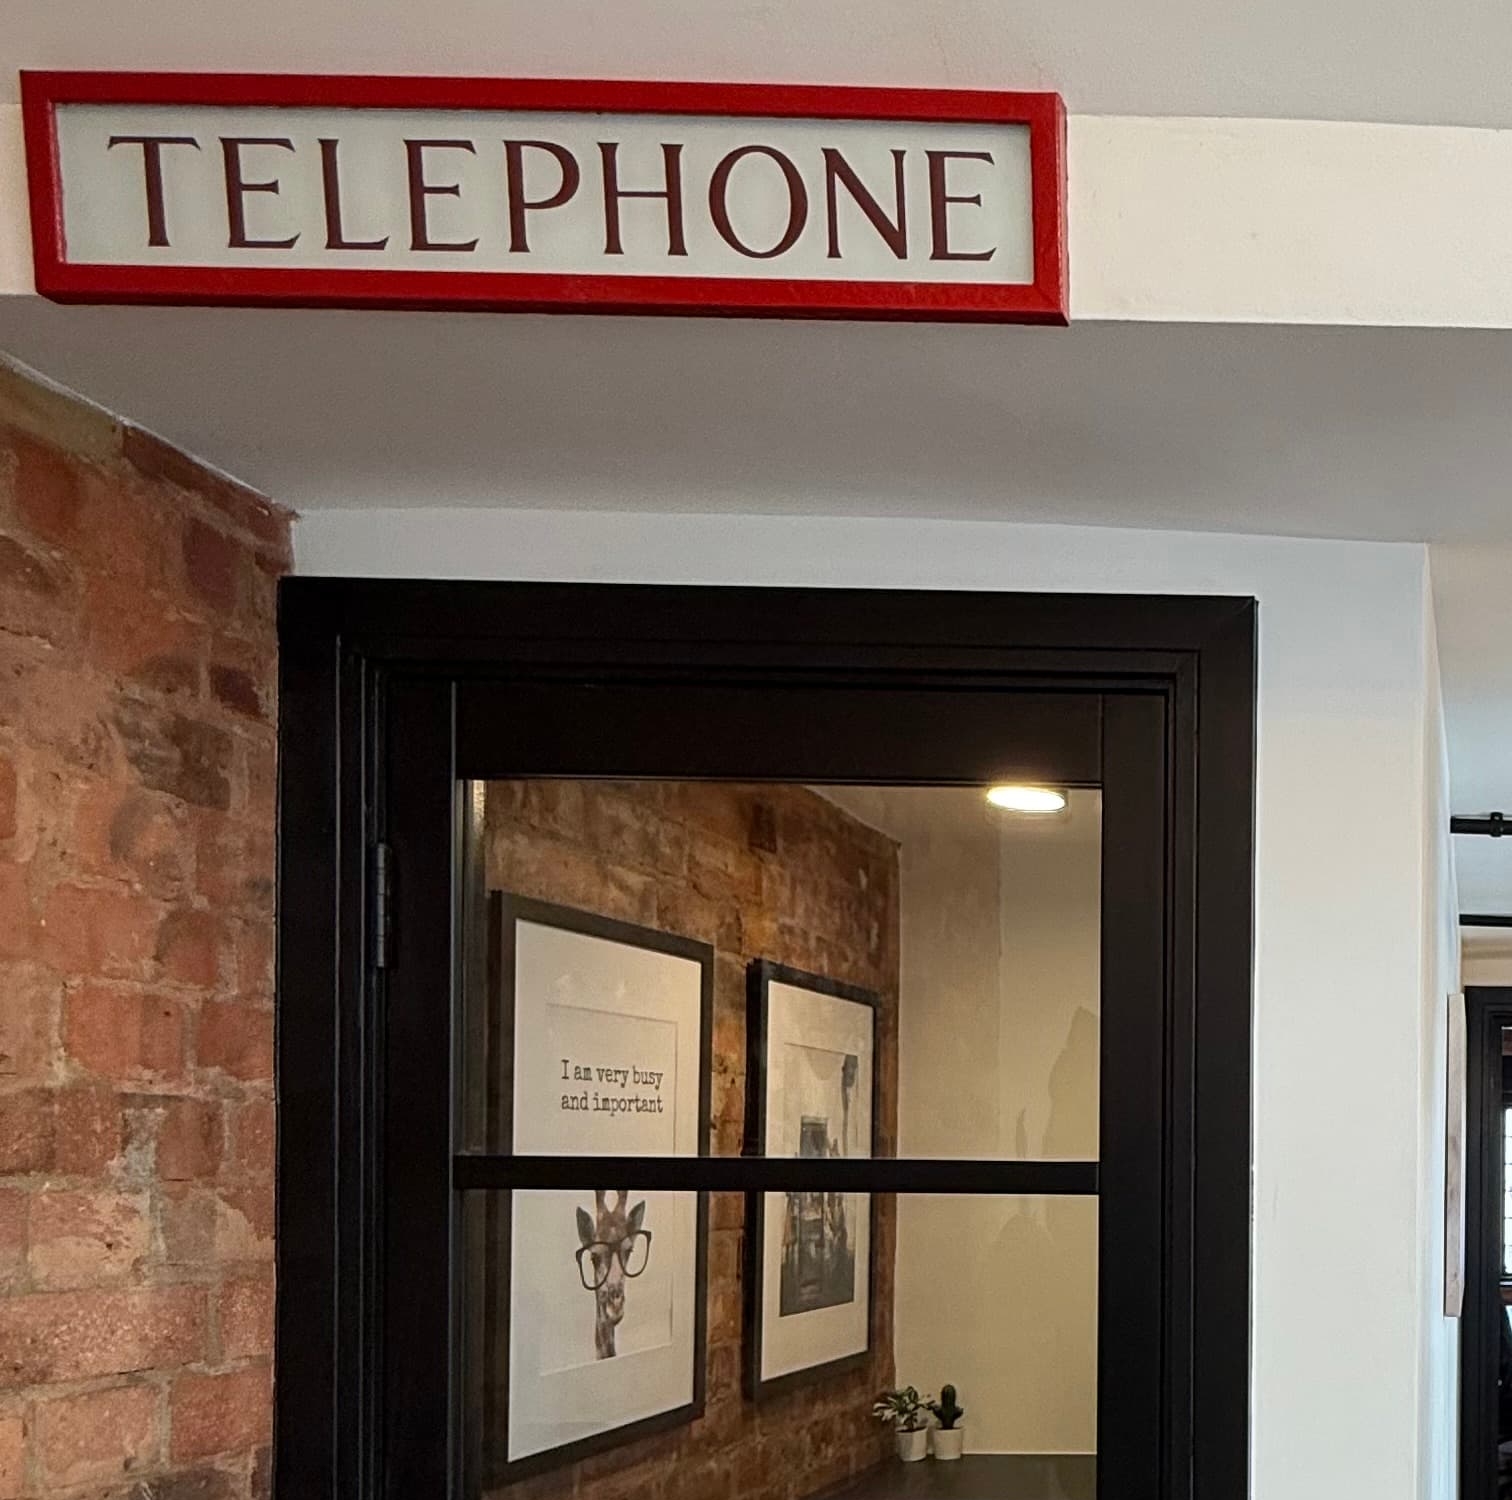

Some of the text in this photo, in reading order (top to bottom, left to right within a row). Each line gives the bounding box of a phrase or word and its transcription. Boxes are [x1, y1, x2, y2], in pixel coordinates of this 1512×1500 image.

[106, 135, 997, 262] TELEPHONE
[561, 1059, 664, 1090] I am very busy
[561, 1091, 664, 1117] and important
